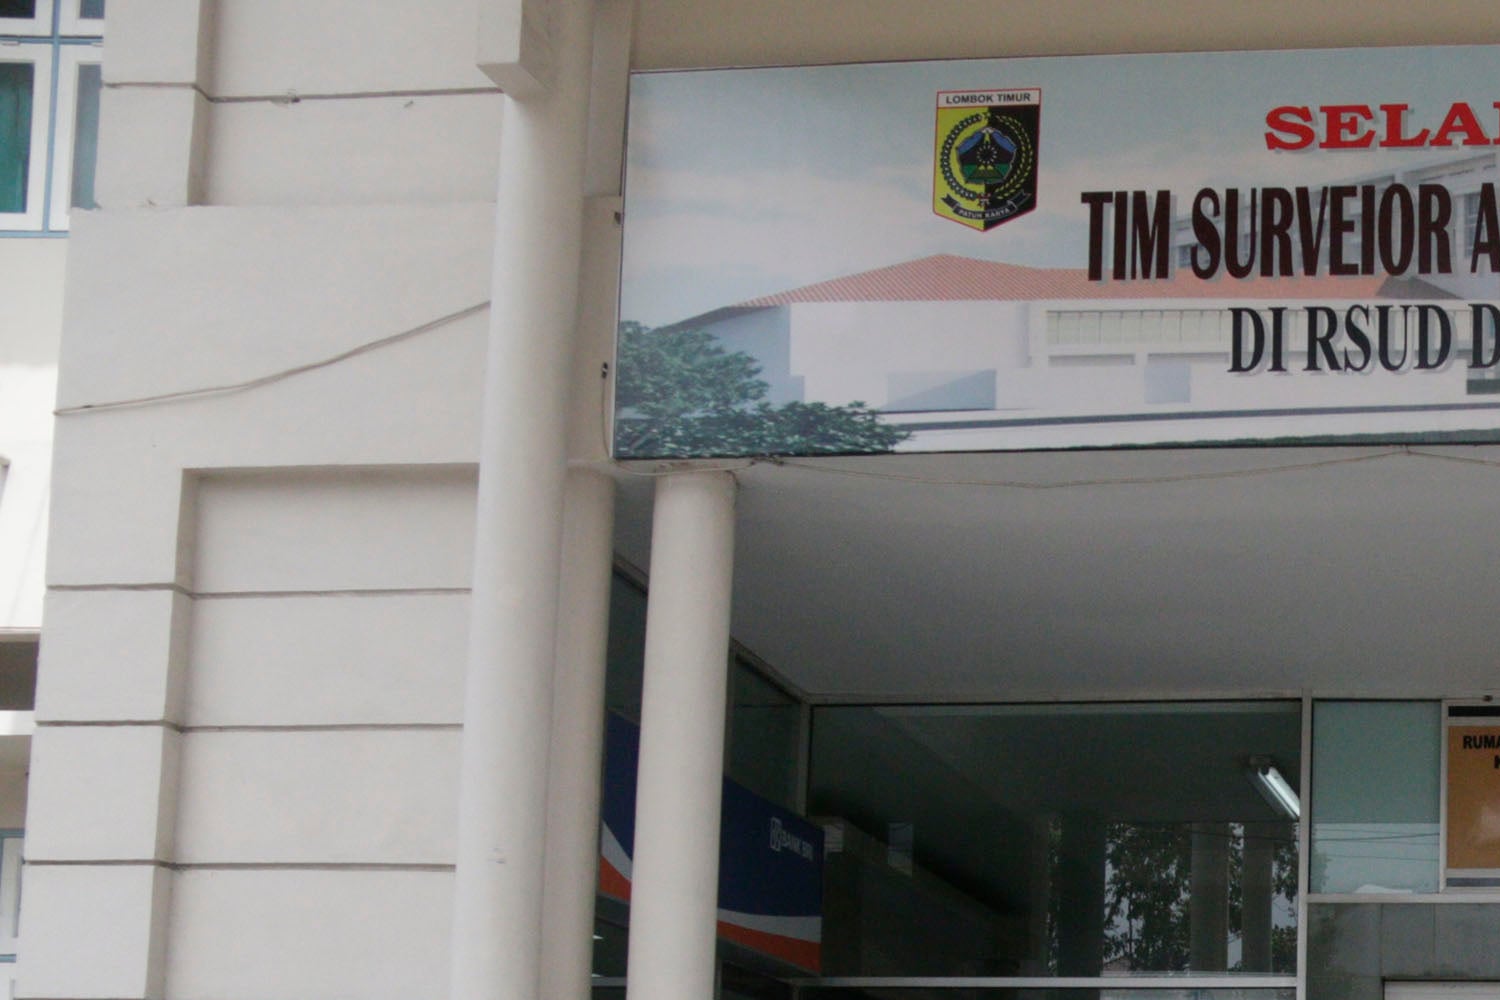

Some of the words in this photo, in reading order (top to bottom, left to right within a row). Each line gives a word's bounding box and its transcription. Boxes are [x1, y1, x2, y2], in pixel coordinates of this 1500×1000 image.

[945, 95, 993, 104] LOMBOK
[997, 92, 1031, 102] TIMUR
[1081, 189, 1171, 281] TIM
[1191, 183, 1453, 280] SURVEIOR
[1228, 306, 1289, 373] DI
[1302, 303, 1452, 372] RSUD
